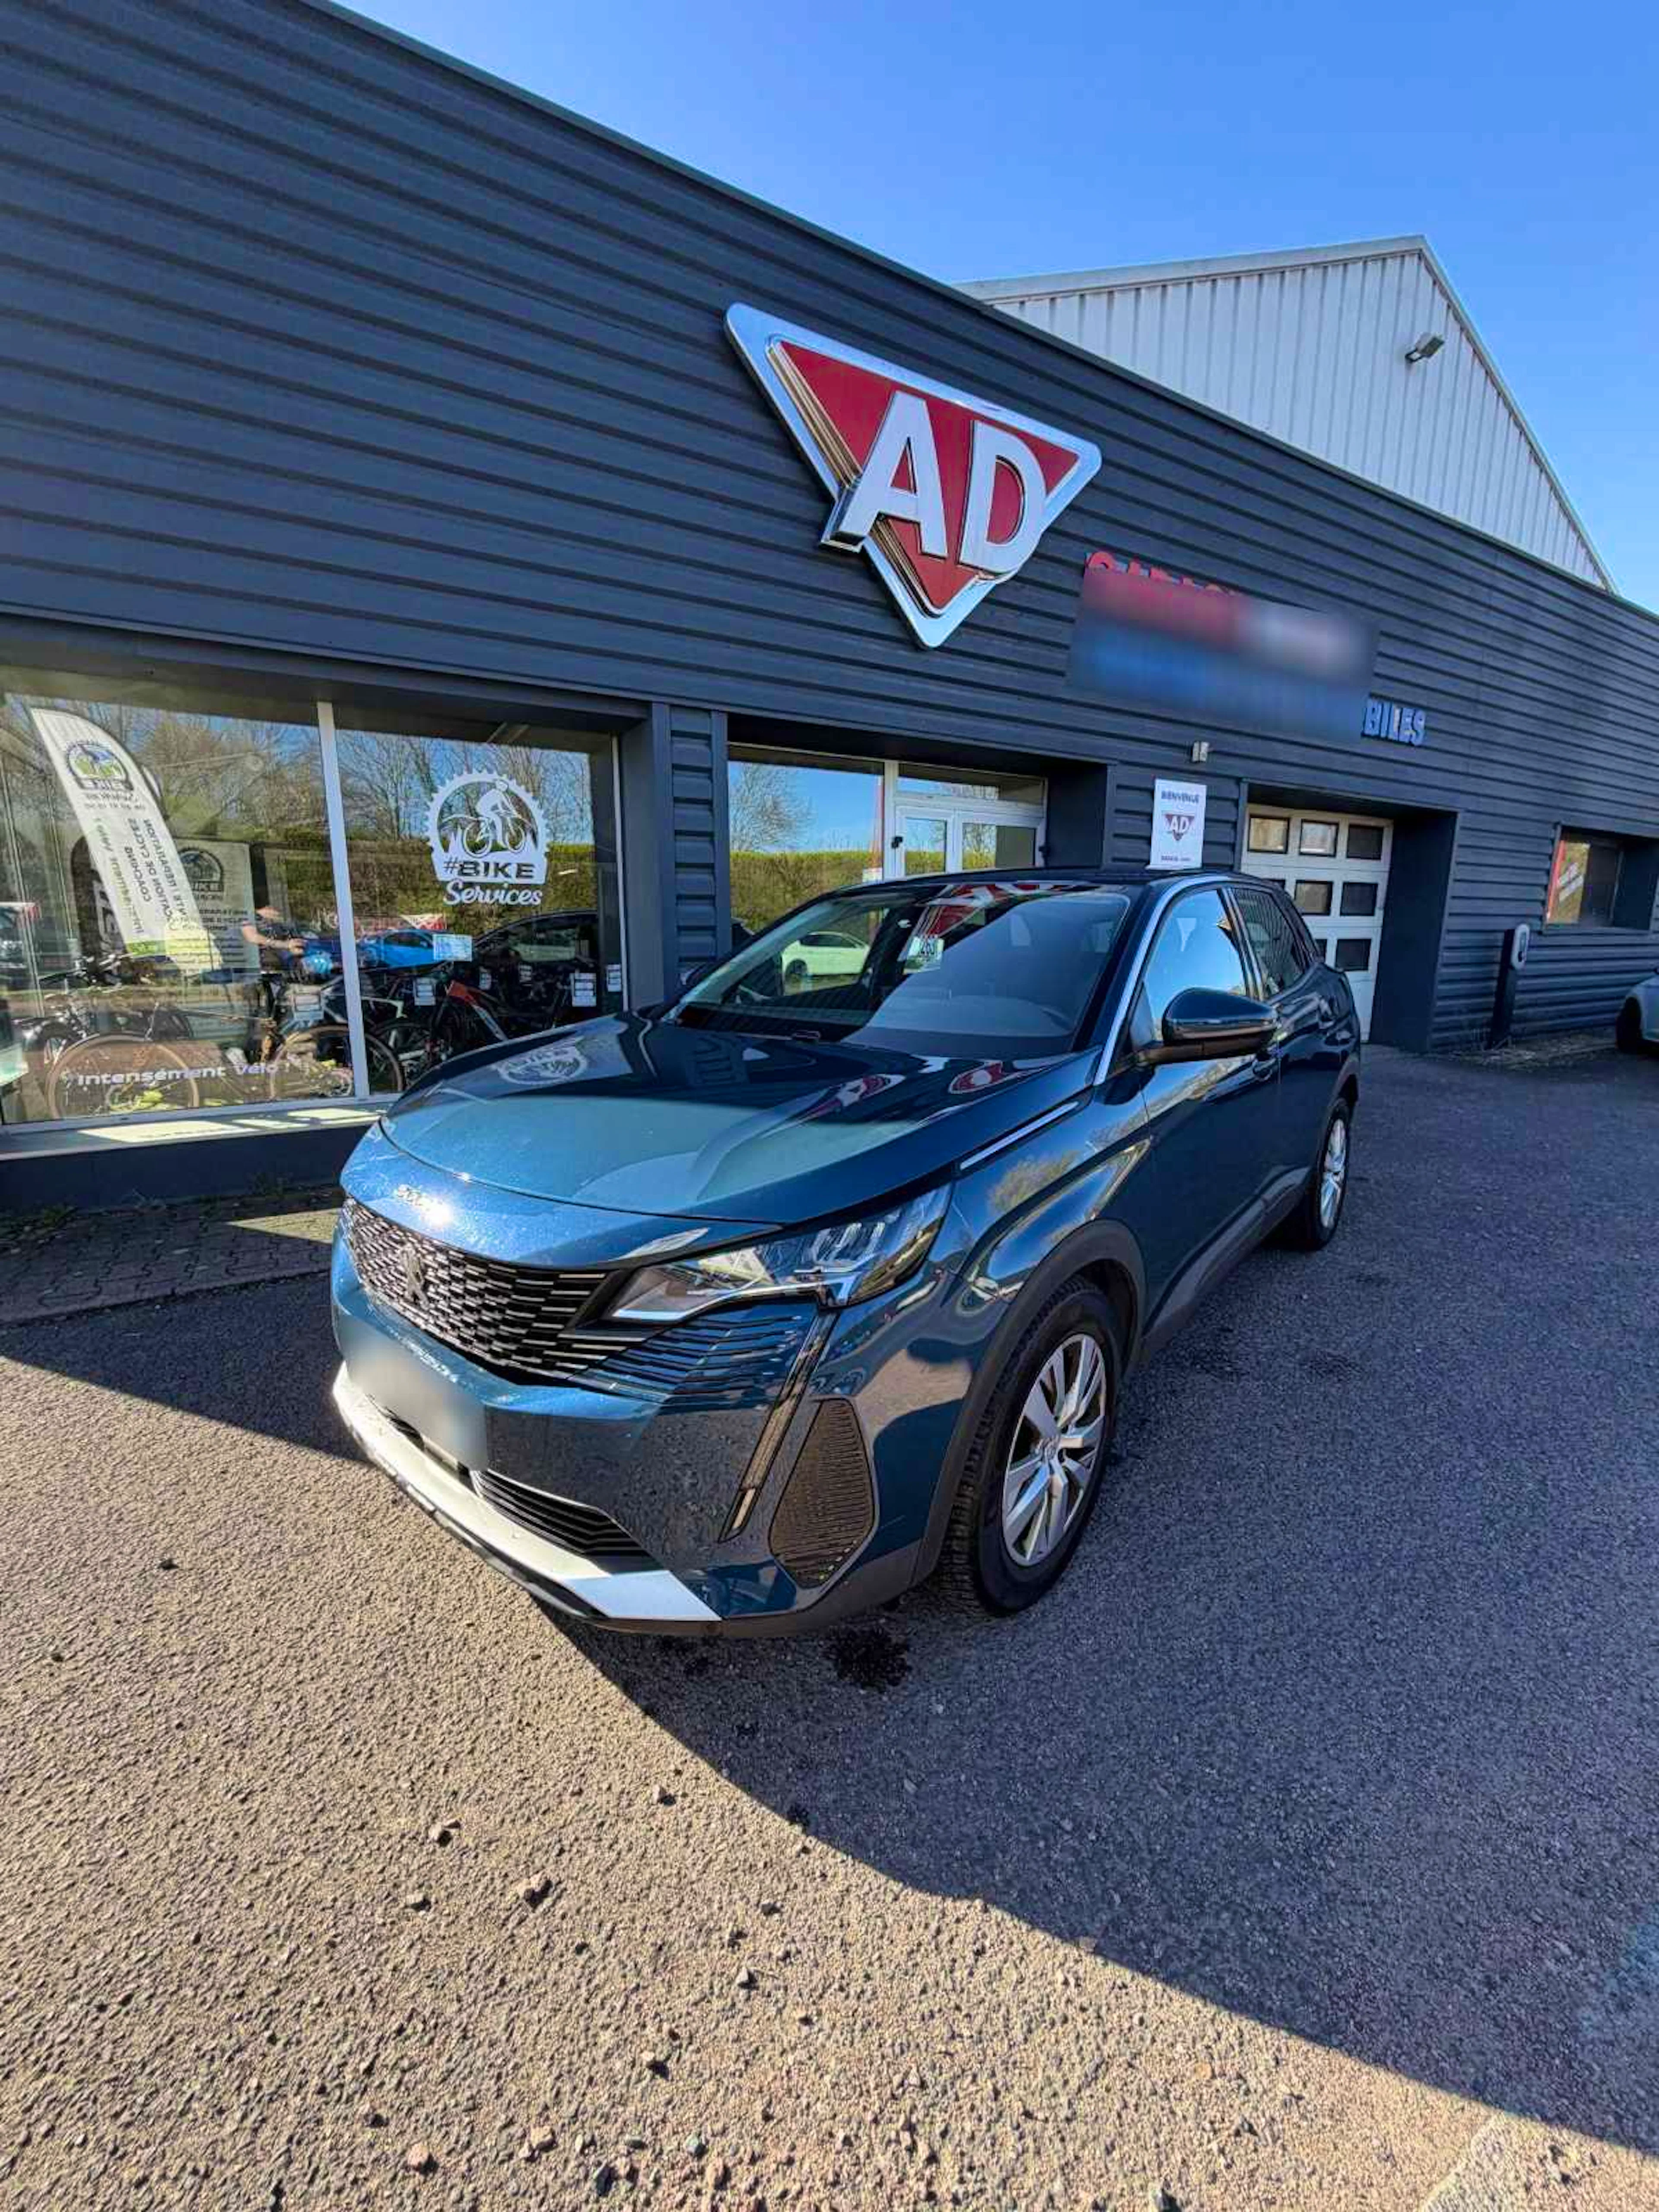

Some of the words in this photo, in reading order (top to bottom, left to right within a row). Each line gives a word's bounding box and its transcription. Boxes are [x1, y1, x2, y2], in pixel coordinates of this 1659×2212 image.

[837, 391, 1048, 575] AD
[1170, 815, 1190, 833] AD
[443, 855, 535, 878] #BIKE
[443, 878, 542, 906] Services
